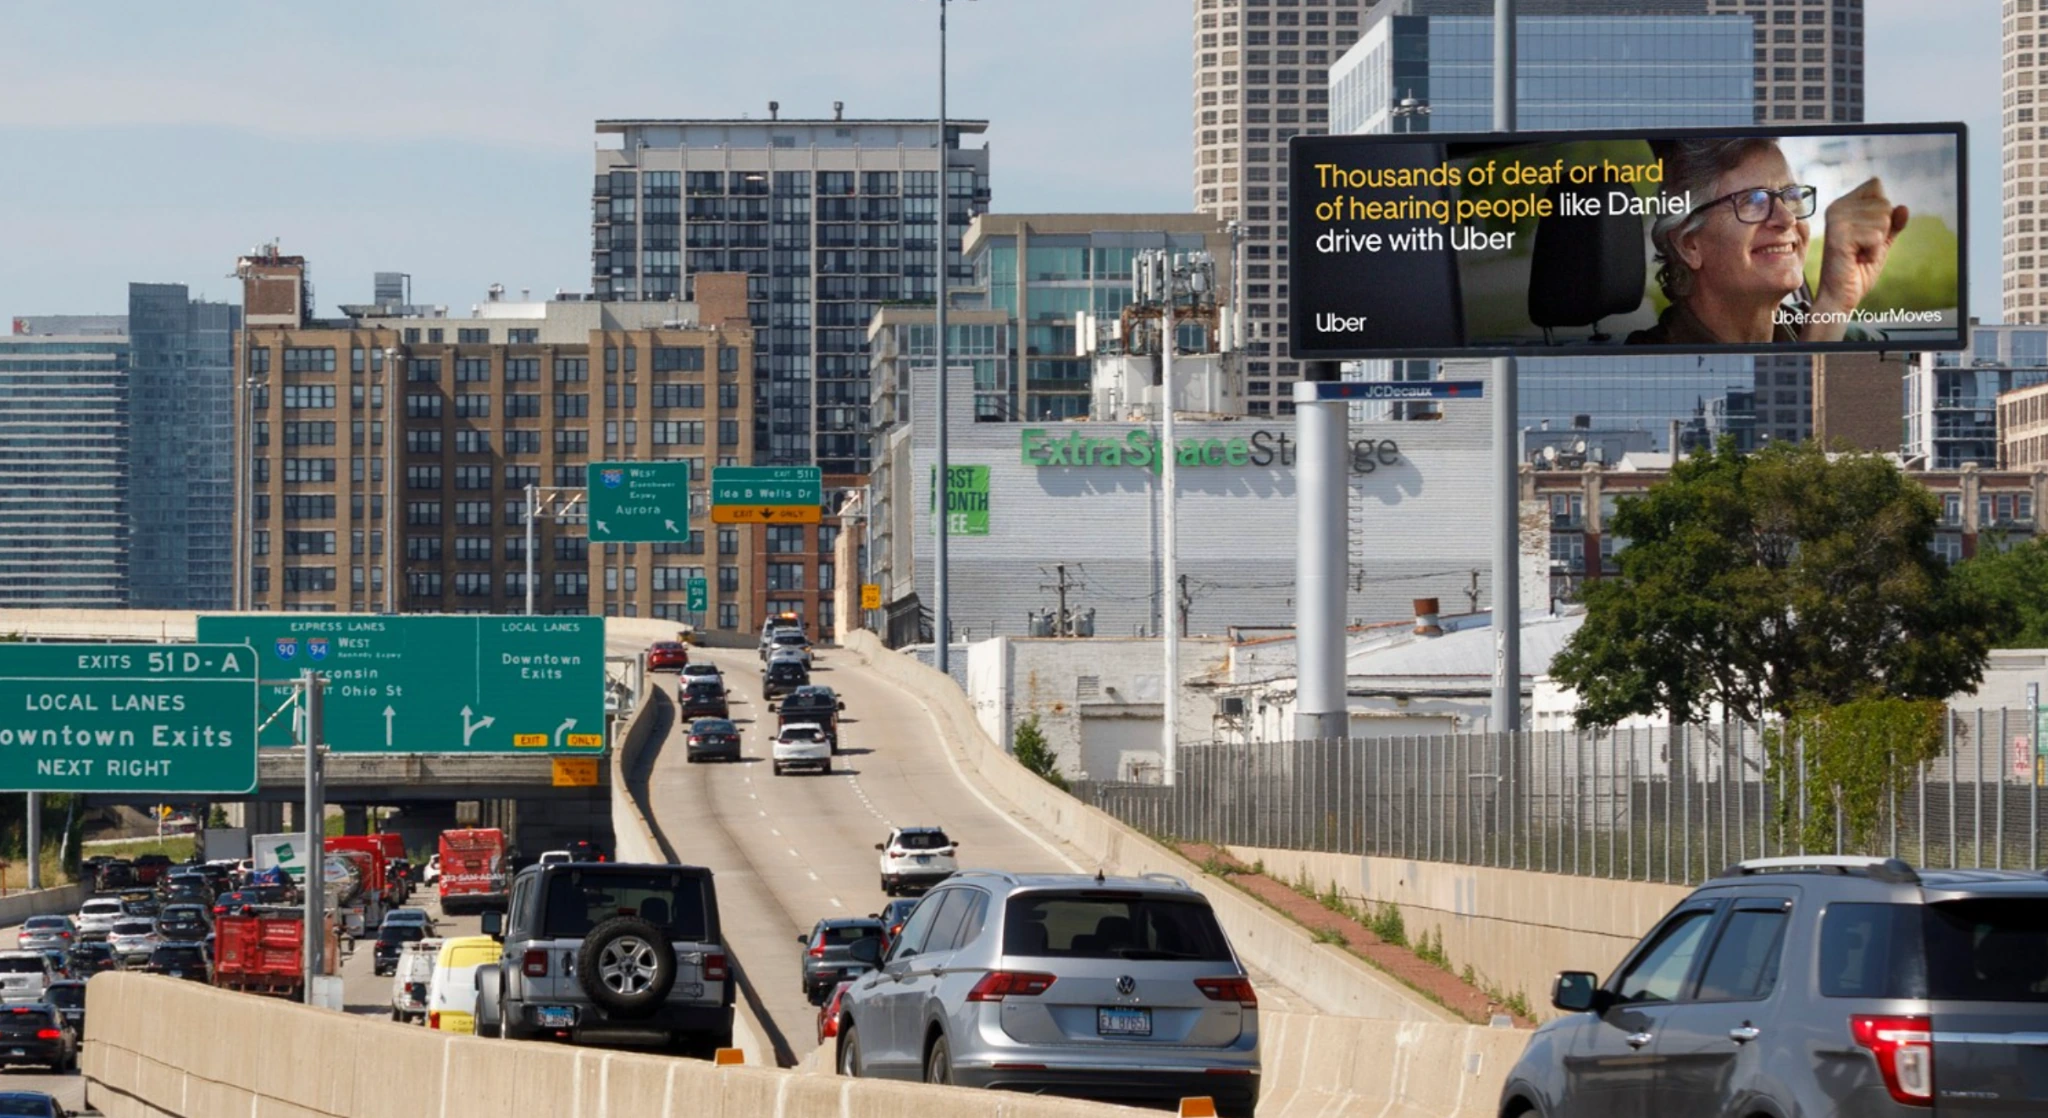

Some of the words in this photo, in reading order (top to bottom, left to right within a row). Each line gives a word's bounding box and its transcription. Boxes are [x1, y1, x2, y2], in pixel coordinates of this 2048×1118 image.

[1314, 161, 1462, 189] Thousands
[1467, 160, 1496, 187] of
[1501, 159, 1564, 185] deaf
[1569, 164, 1597, 184] or
[1603, 158, 1664, 183] hard
[1315, 195, 1344, 221] of
[1349, 195, 1449, 225] hearing
[1456, 192, 1553, 224] people
[1559, 192, 1600, 216] like
[1608, 190, 1691, 215] Daniel
[1316, 228, 1382, 253] drive
[1388, 226, 1444, 252] with
[1450, 225, 1516, 251] Uber
[1316, 312, 1367, 333] Uber
[1771, 307, 1943, 325] Uber.com/YourMoves
[1365, 384, 1433, 398] JCDecaux
[629, 469, 657, 478] WEST
[774, 470, 791, 478] EXIT
[720, 489, 739, 499] Ida
[744, 489, 753, 498] B
[759, 489, 792, 499] Wells
[797, 489, 812, 499] Dr
[615, 504, 661, 515] Aurora
[733, 509, 753, 518] EXIT
[779, 509, 804, 518] ONLY
[290, 622, 342, 632] EXPRESS
[347, 622, 386, 632] LANES
[501, 622, 538, 632] LOCAL
[543, 622, 580, 632] LANES
[278, 644, 295, 656] 90
[310, 644, 327, 655] 94
[338, 637, 370, 648] WEST
[78, 655, 132, 669] EXITS
[502, 652, 581, 665] Downtown
[521, 667, 562, 680] Exits
[341, 685, 377, 697] Ohio
[386, 684, 403, 697] St
[26, 694, 99, 711] LOCAL
[112, 695, 186, 712] LANES
[152, 725, 233, 747] Exits
[520, 736, 541, 745] EXIT
[571, 735, 597, 745] ONLY
[37, 759, 94, 776] NEXT
[107, 760, 172, 776] RIGHT
[1940, 1090, 1999, 1099] LIMITED
